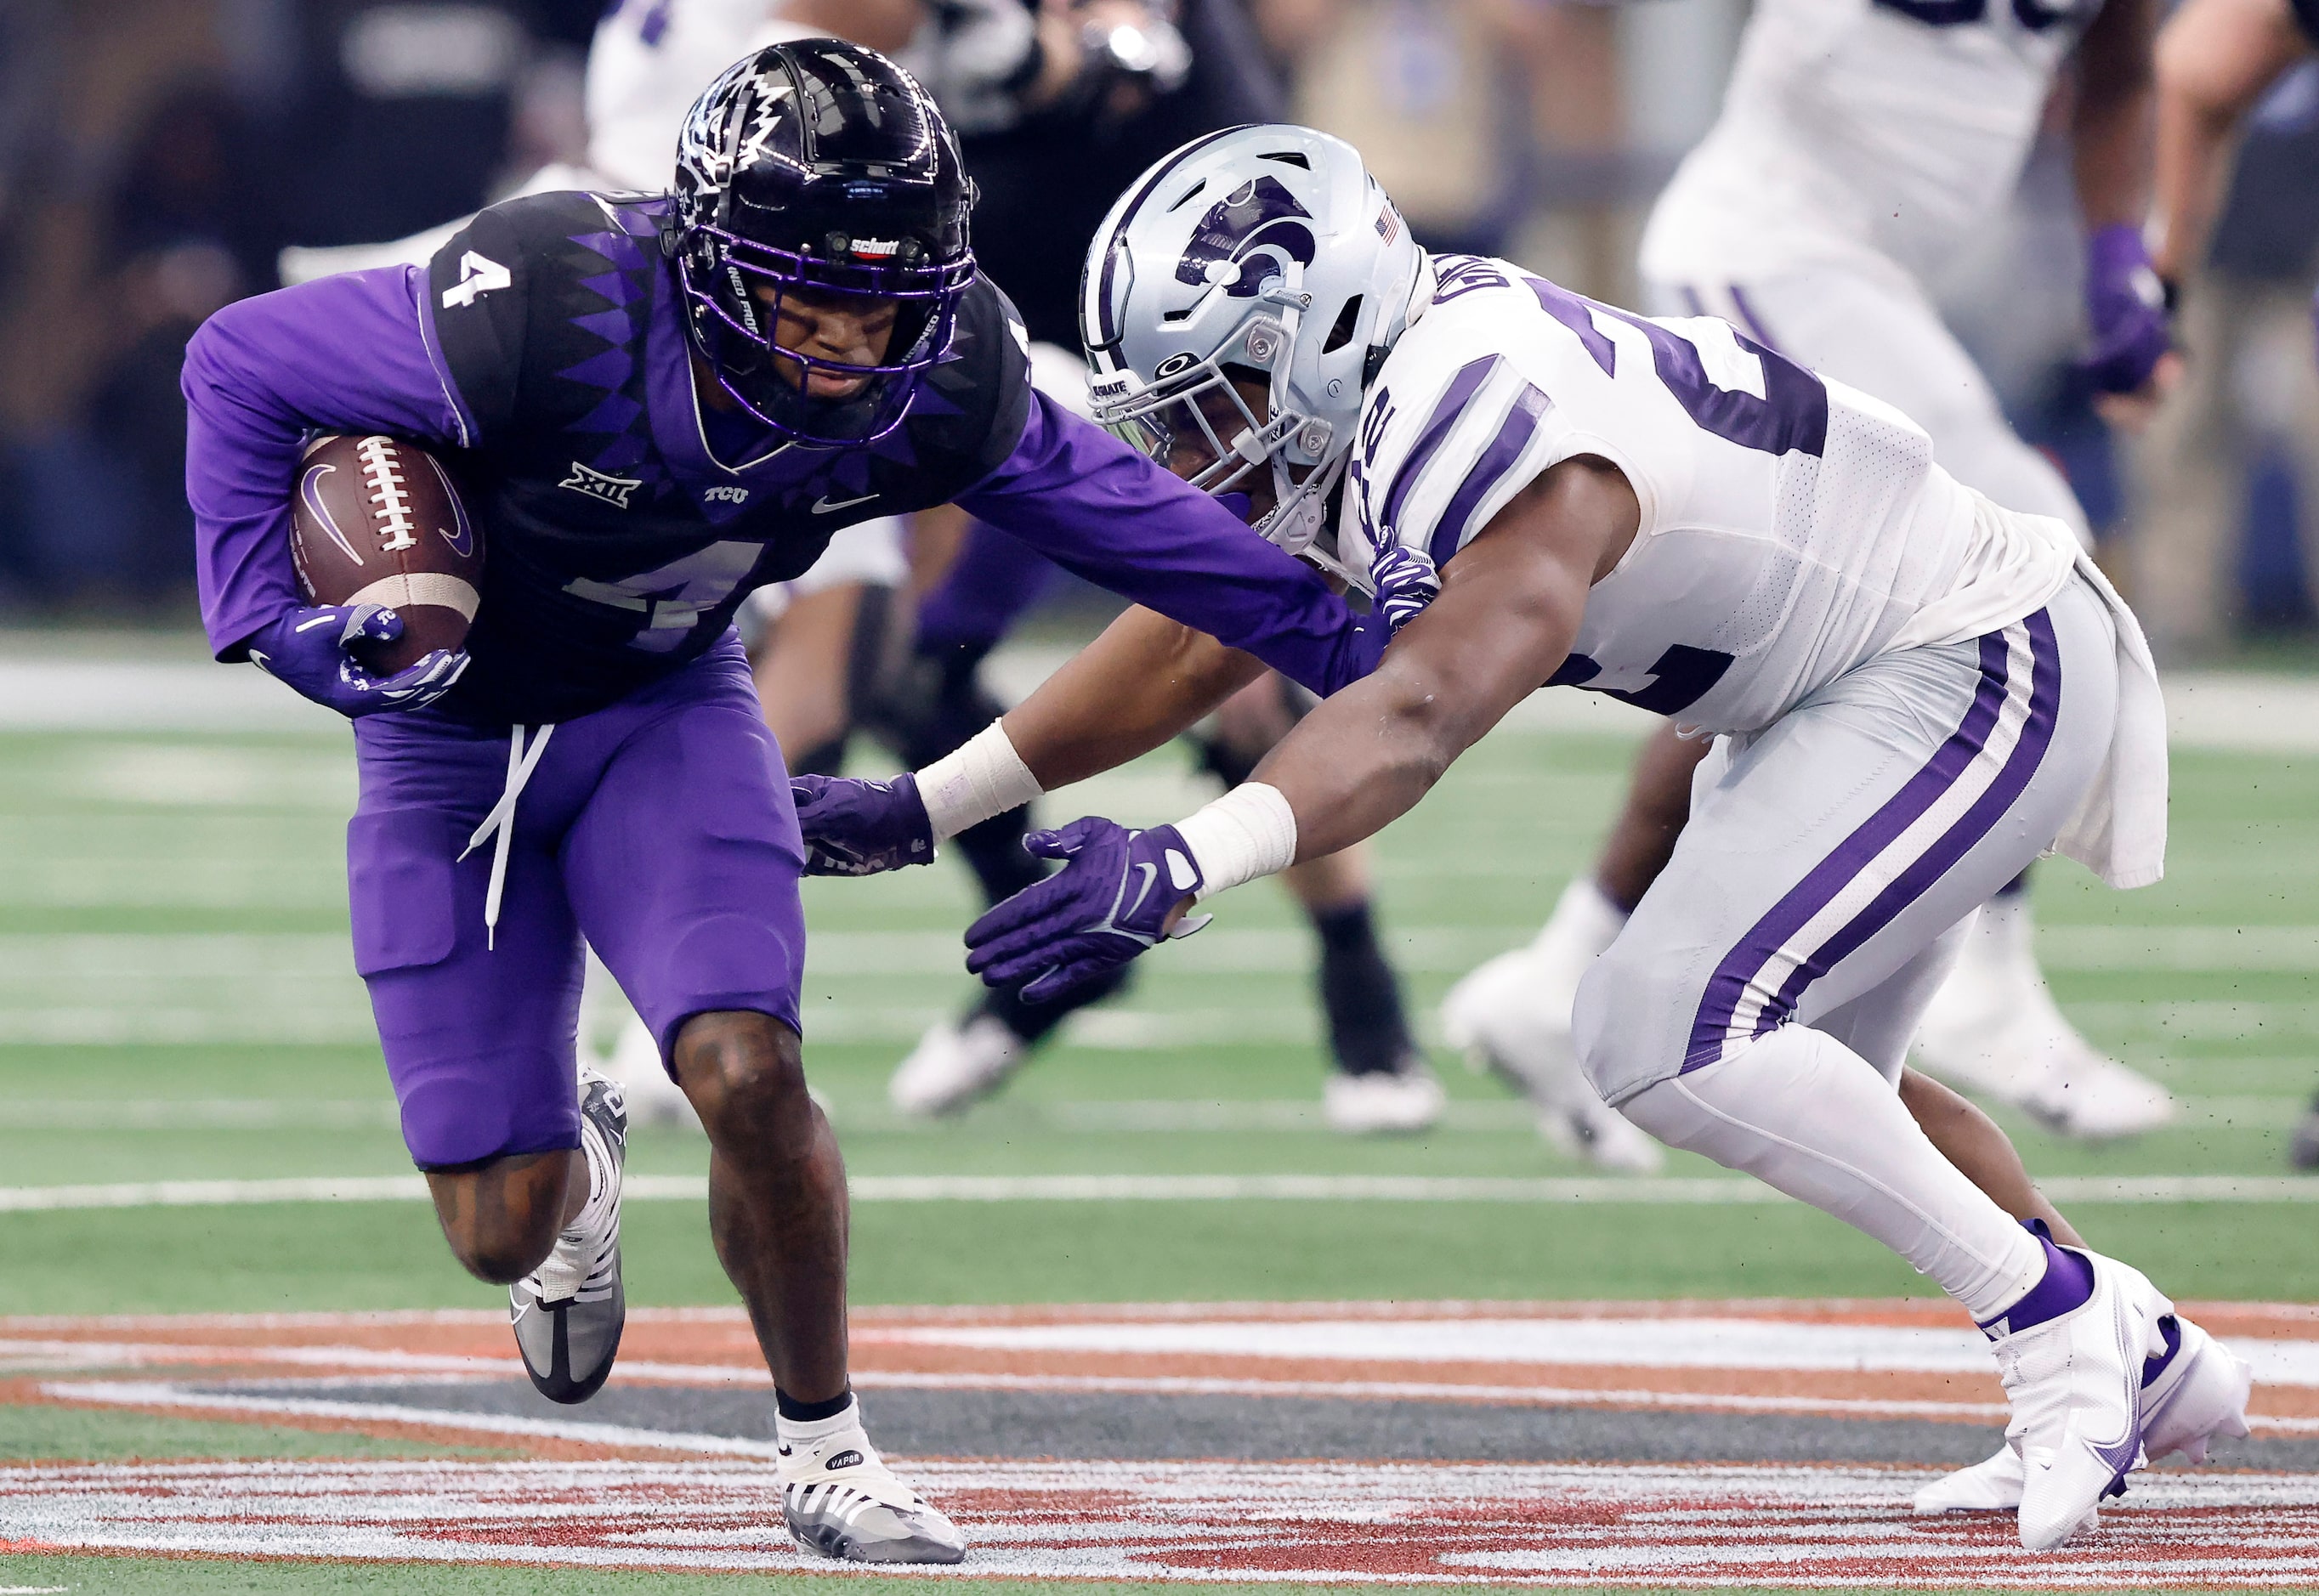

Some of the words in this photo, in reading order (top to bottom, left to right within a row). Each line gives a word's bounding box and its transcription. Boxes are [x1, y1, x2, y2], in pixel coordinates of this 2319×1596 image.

[850, 237, 899, 255] schutt
[442, 250, 511, 308] 4
[705, 486, 749, 504] TCU
[561, 540, 765, 653] 4
[831, 1453, 859, 1469] VAPOR
